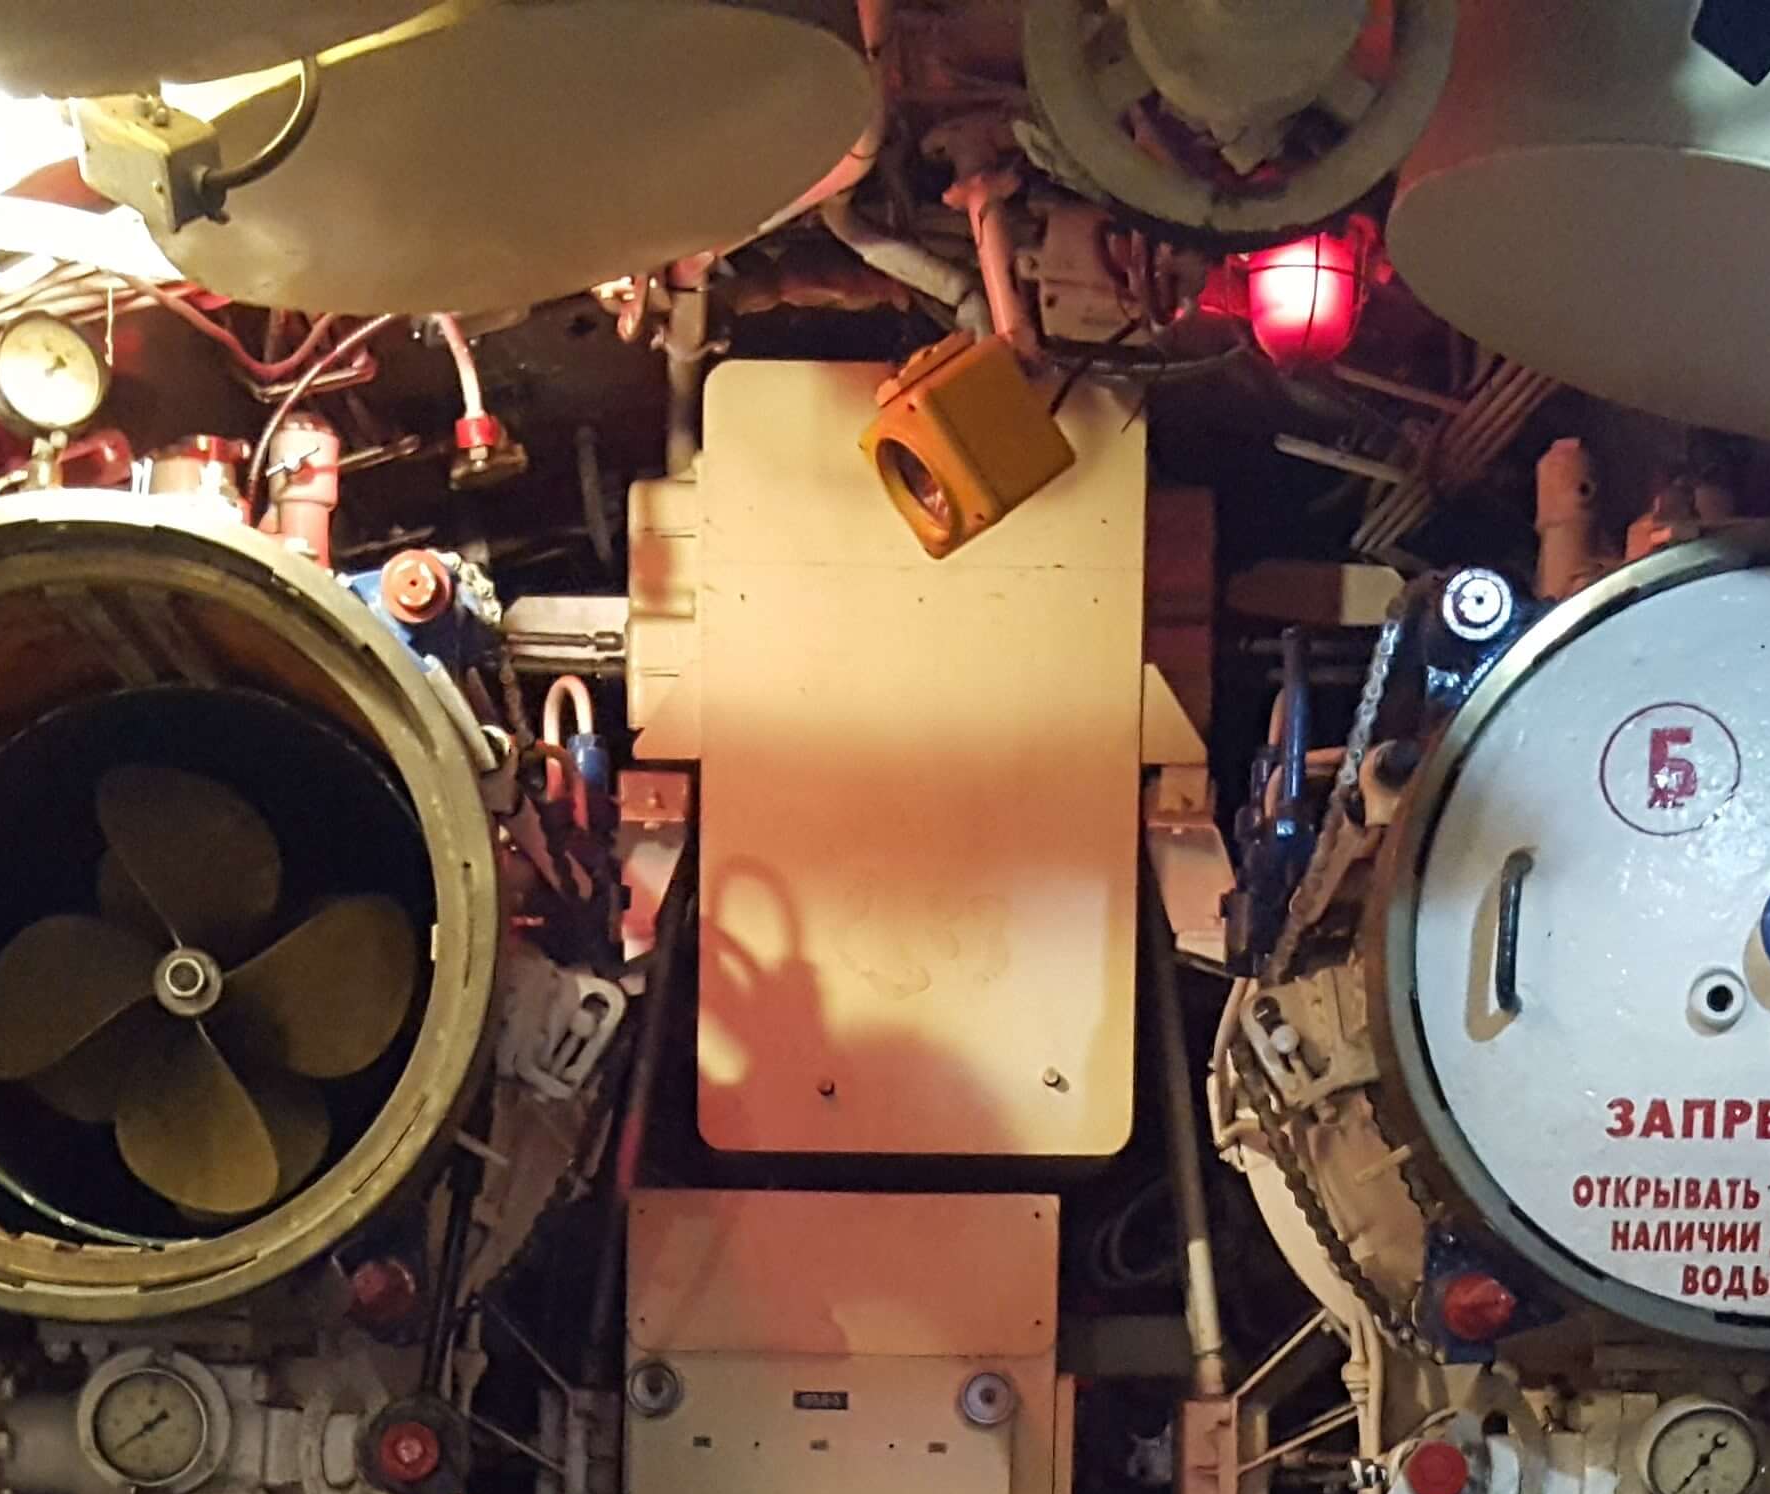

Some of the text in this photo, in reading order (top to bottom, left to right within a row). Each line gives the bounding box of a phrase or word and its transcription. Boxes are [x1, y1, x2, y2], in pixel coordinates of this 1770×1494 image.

[1648, 727, 1698, 809] Б
[1572, 1174, 1760, 1209] ОТКРЫВАТЬ
[1610, 1220, 1761, 1253] НАЛИЧИИ
